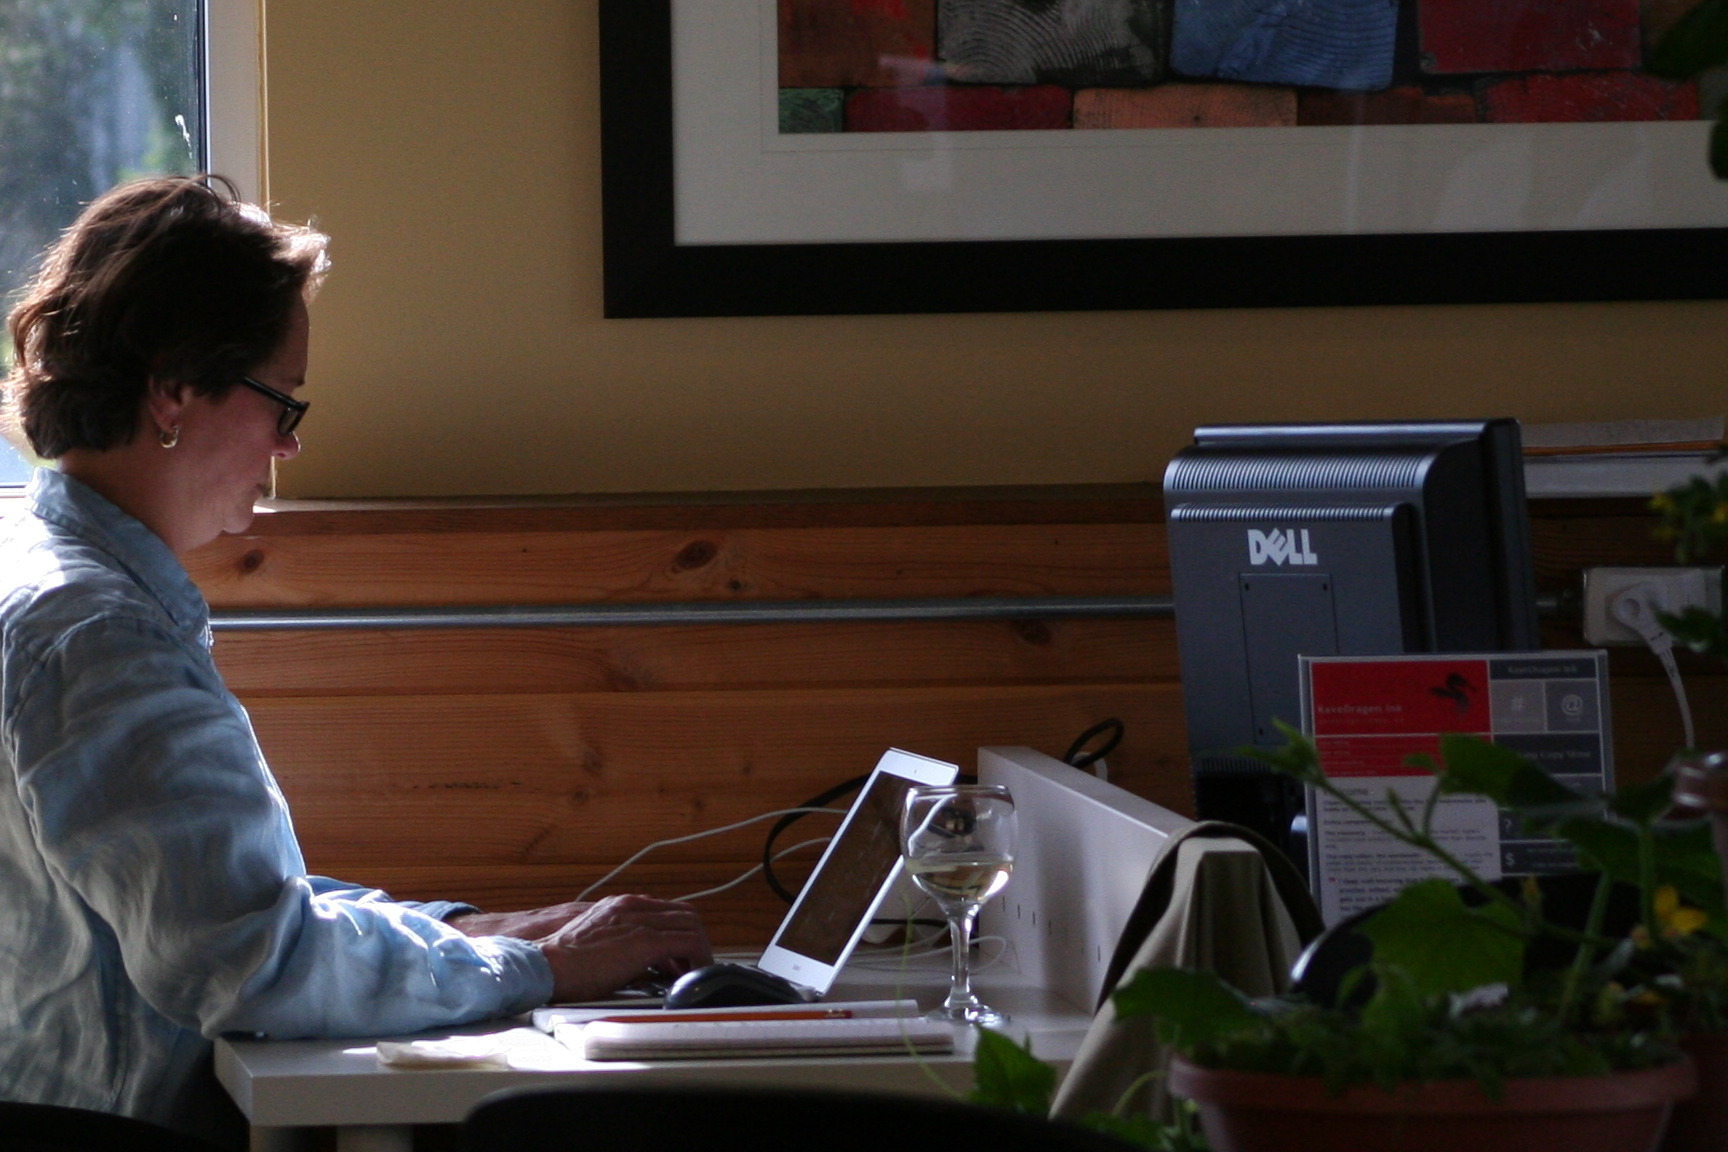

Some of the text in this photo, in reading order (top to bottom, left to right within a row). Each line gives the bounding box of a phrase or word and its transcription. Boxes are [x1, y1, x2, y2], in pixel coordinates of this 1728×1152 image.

[1247, 527, 1318, 567] DELL
[1561, 694, 1583, 715] @
[1504, 852, 1515, 868] $
